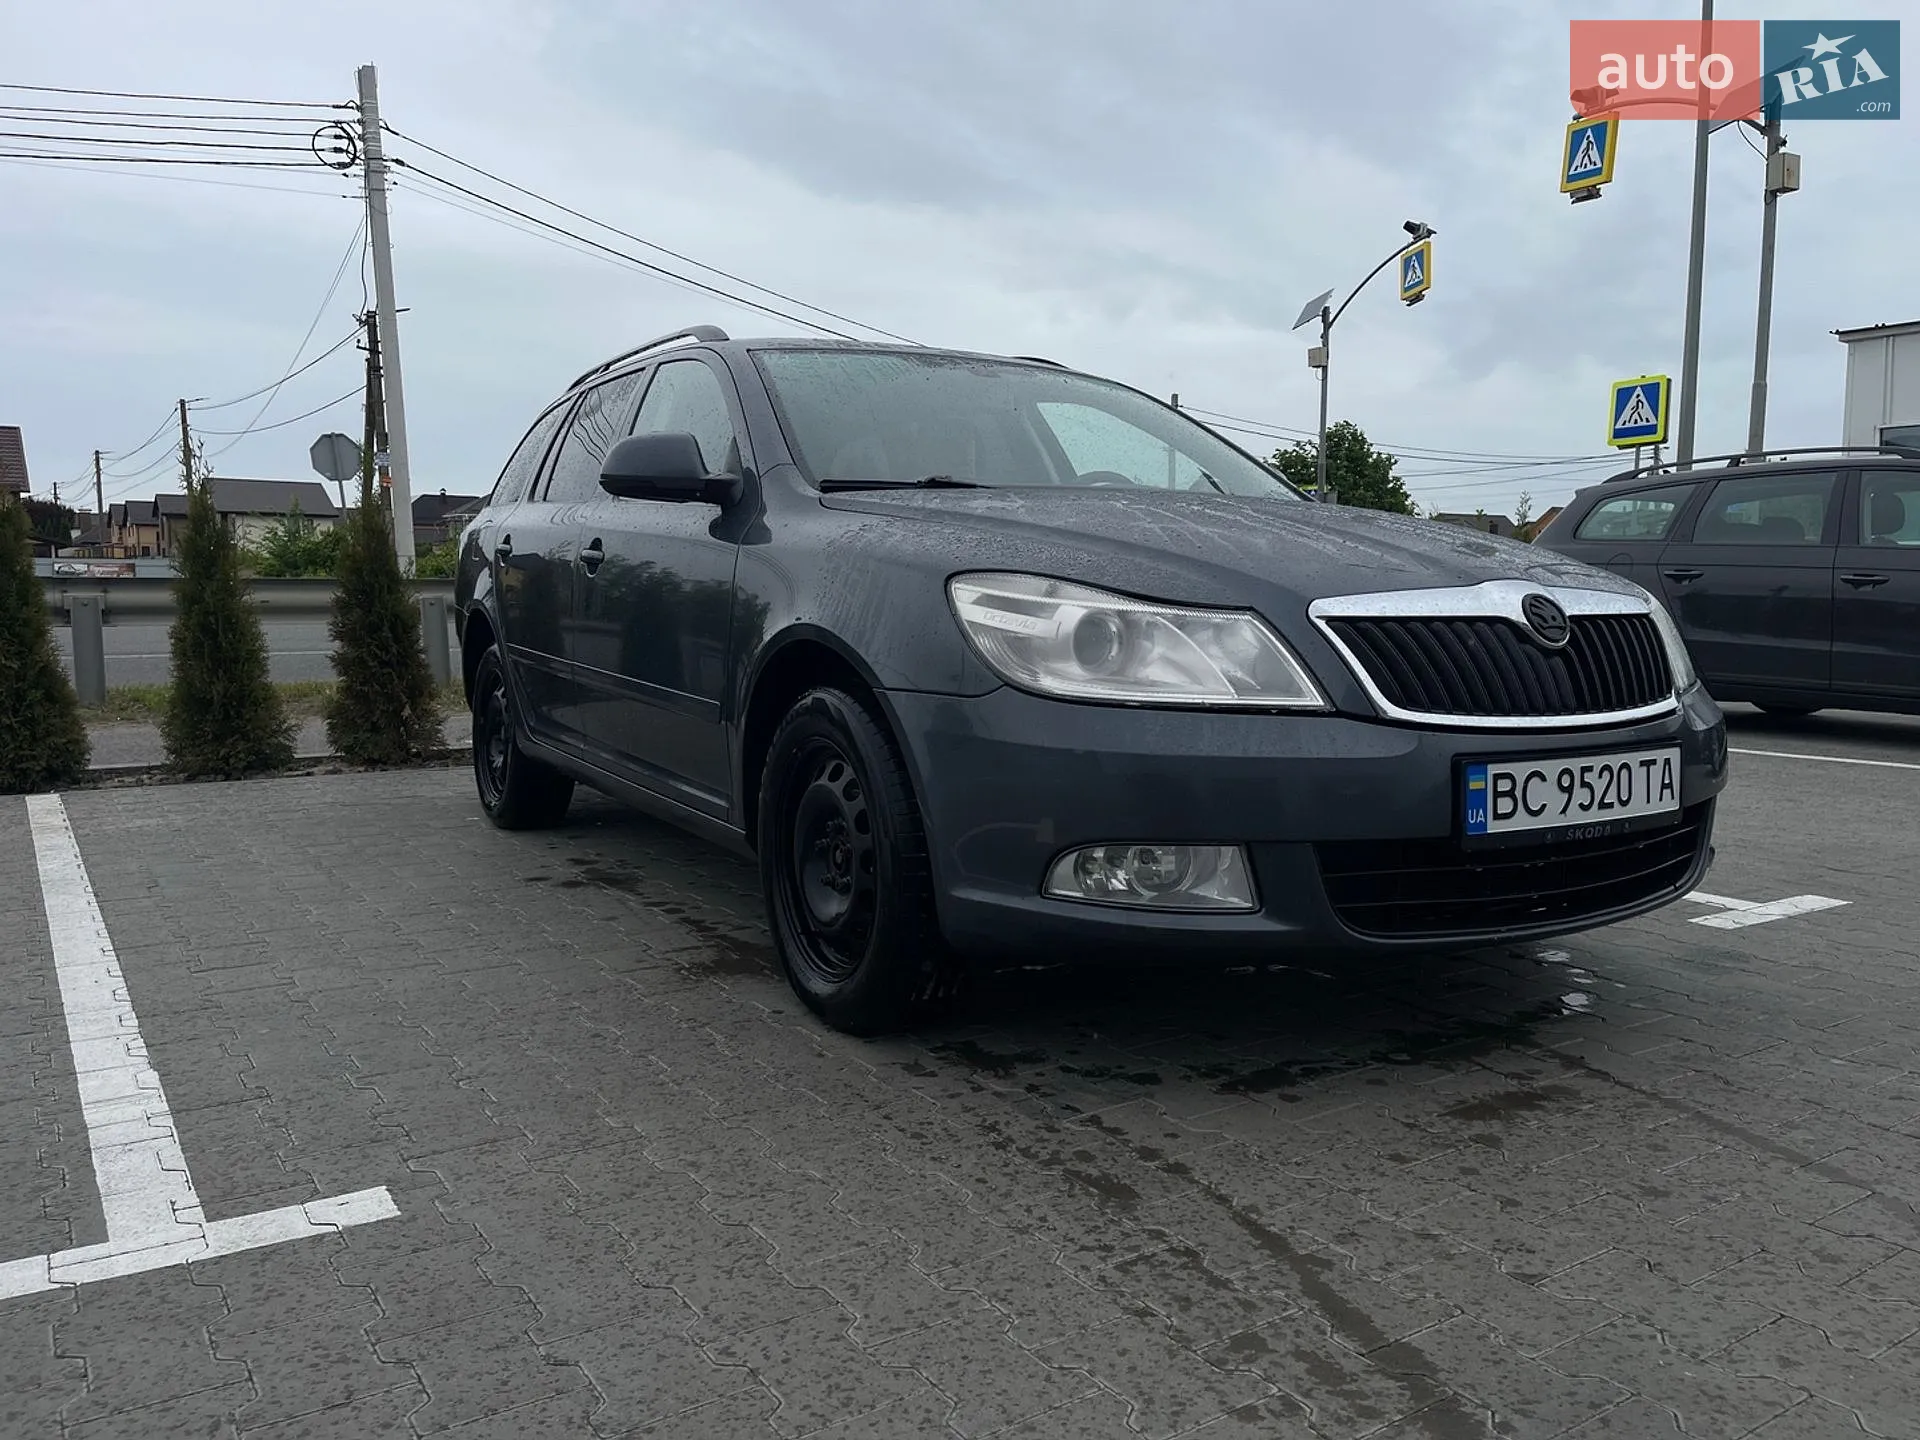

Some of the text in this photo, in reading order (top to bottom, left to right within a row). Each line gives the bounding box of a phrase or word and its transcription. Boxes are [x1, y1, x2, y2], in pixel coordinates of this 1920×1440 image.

[1492, 757, 1675, 821] BC 9520 TA
[1468, 808, 1486, 824] UA
